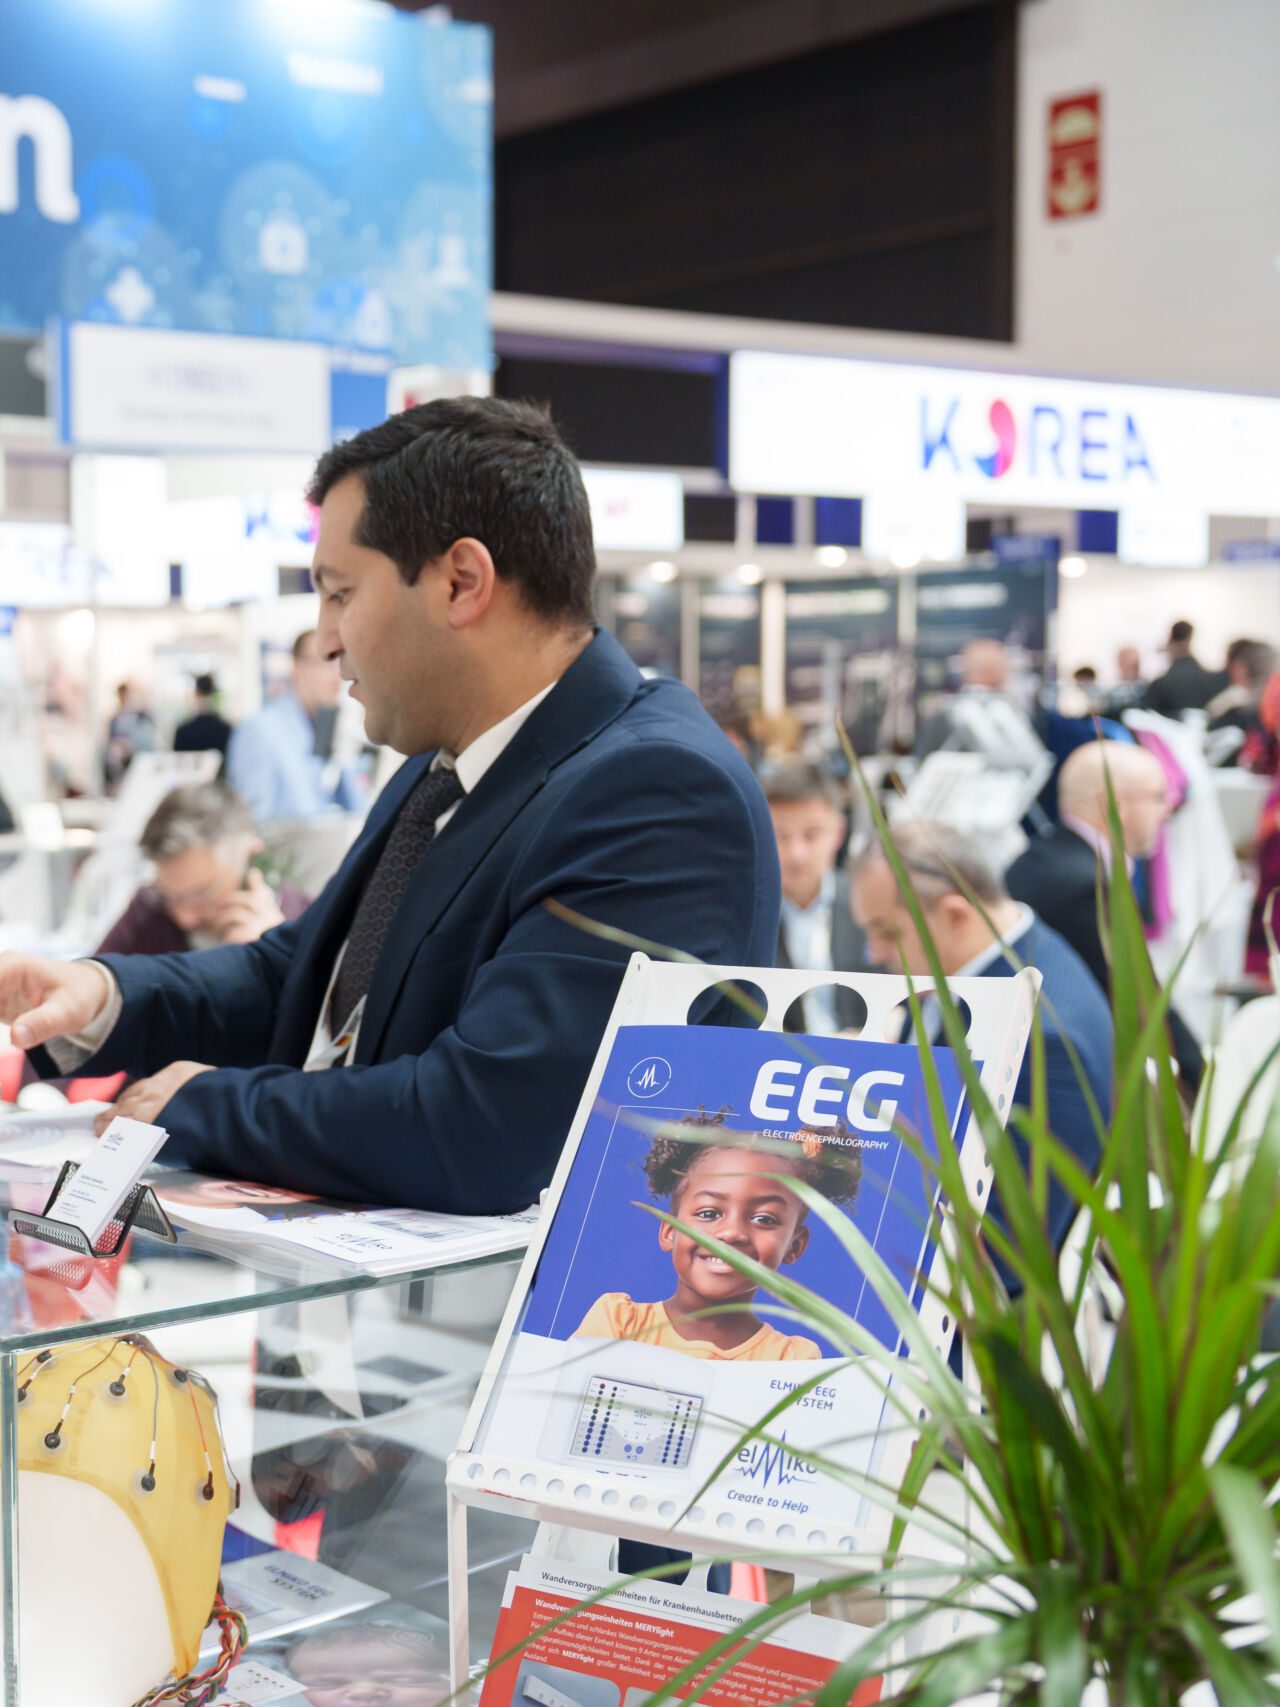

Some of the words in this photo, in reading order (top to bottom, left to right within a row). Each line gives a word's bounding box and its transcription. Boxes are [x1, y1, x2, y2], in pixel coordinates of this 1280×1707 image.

[919, 398, 1157, 482] KOREA
[749, 1059, 905, 1132] EEG
[762, 1129, 889, 1151] ELECTROENCEPHALOGRAPHY
[770, 1380, 811, 1394] ELMI
[815, 1386, 837, 1398] EEG
[791, 1396, 833, 1410] YSTEM
[727, 1489, 764, 1505] Create
[767, 1497, 779, 1508] to
[781, 1499, 809, 1515] Help
[649, 1595, 661, 1605] für
[663, 1599, 743, 1624] Krankenhausbetten
